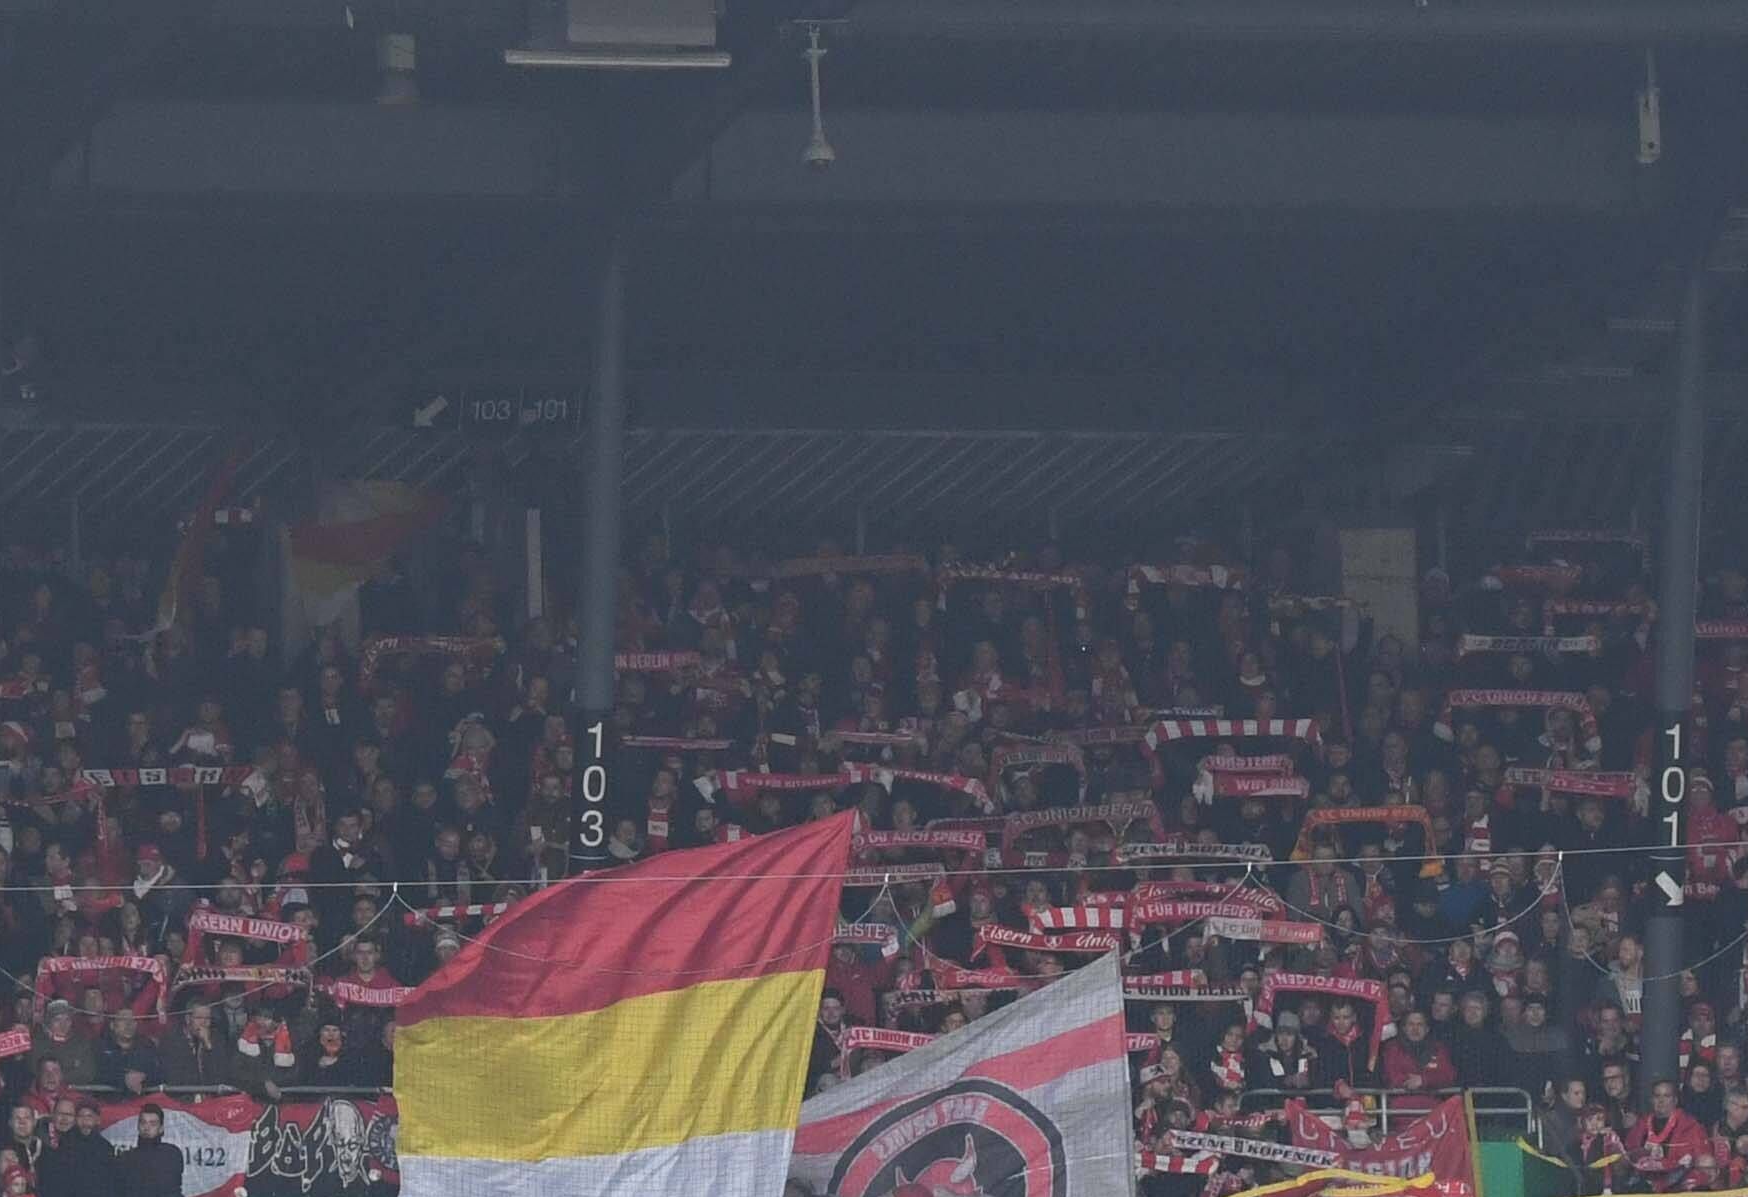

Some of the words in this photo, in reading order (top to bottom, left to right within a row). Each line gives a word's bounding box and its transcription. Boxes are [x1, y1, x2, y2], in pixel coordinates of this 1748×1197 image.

[471, 400, 512, 422] 103
[578, 721, 608, 848] 103
[1660, 722, 1687, 848] 101
